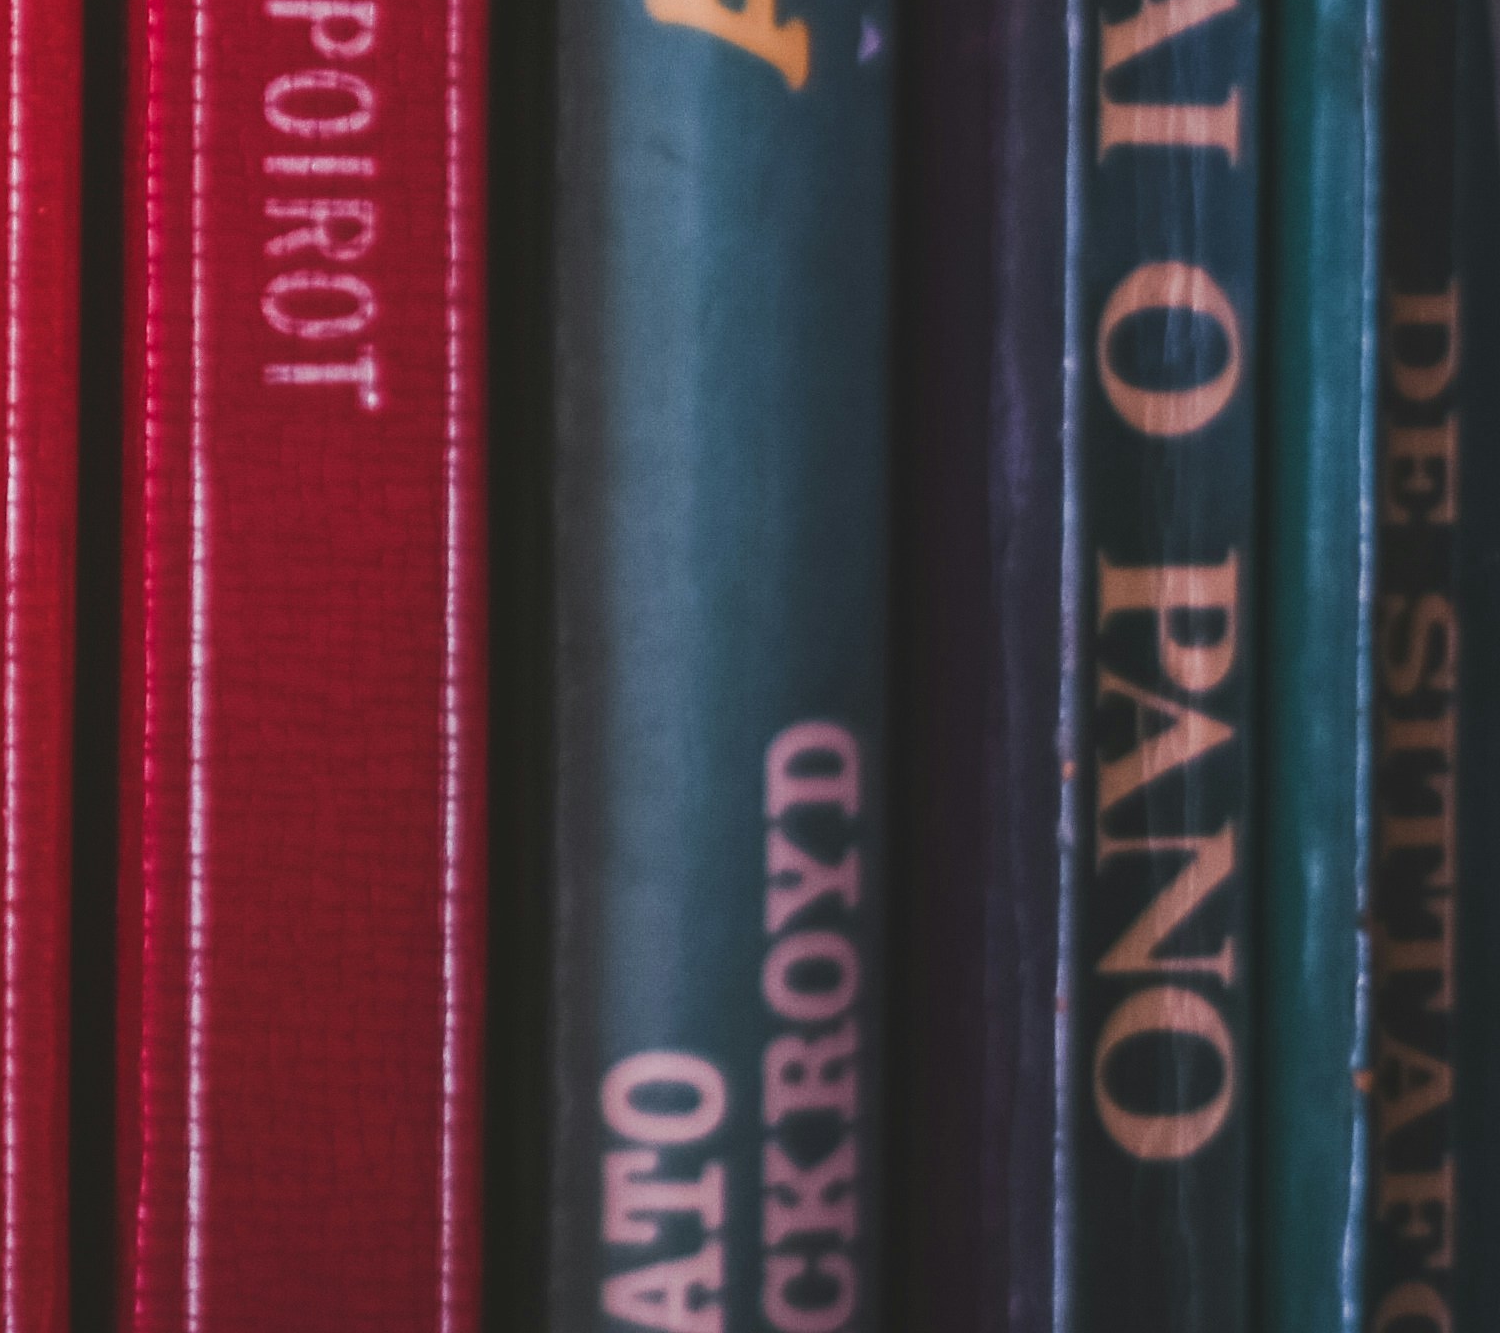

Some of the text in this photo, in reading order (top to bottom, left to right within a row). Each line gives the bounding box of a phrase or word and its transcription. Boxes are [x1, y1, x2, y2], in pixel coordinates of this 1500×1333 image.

[1100, 261, 1240, 436] O
[1386, 273, 1460, 523] DE
[1096, 547, 1238, 1159] PANO
